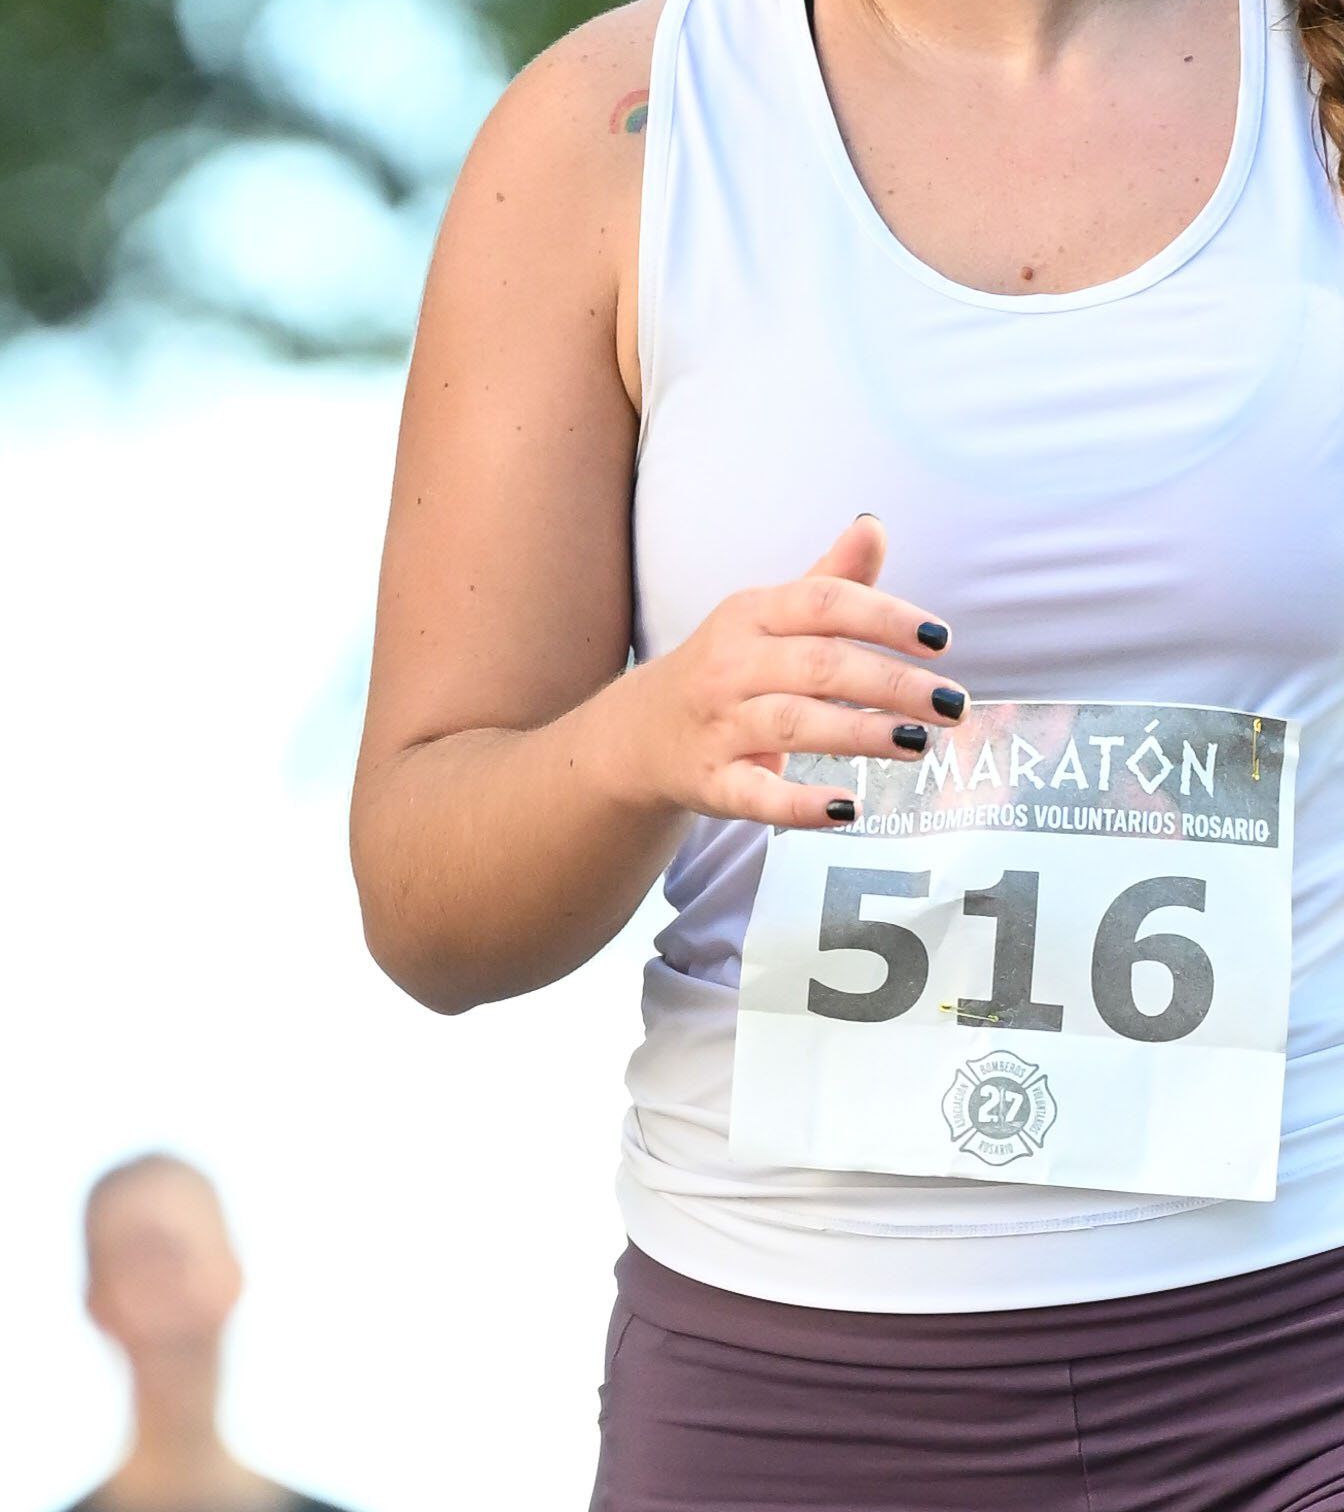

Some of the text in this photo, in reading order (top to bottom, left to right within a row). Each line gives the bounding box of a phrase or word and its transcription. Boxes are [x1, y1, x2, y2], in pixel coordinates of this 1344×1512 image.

[915, 719, 1218, 797] MARATÓN
[919, 804, 1029, 834] BOMBEROS
[1034, 805, 1176, 836] VOLUNTARIOS
[1182, 811, 1271, 843] ROSARIO
[807, 866, 1215, 1043] 516
[978, 1084, 1024, 1123] 27
